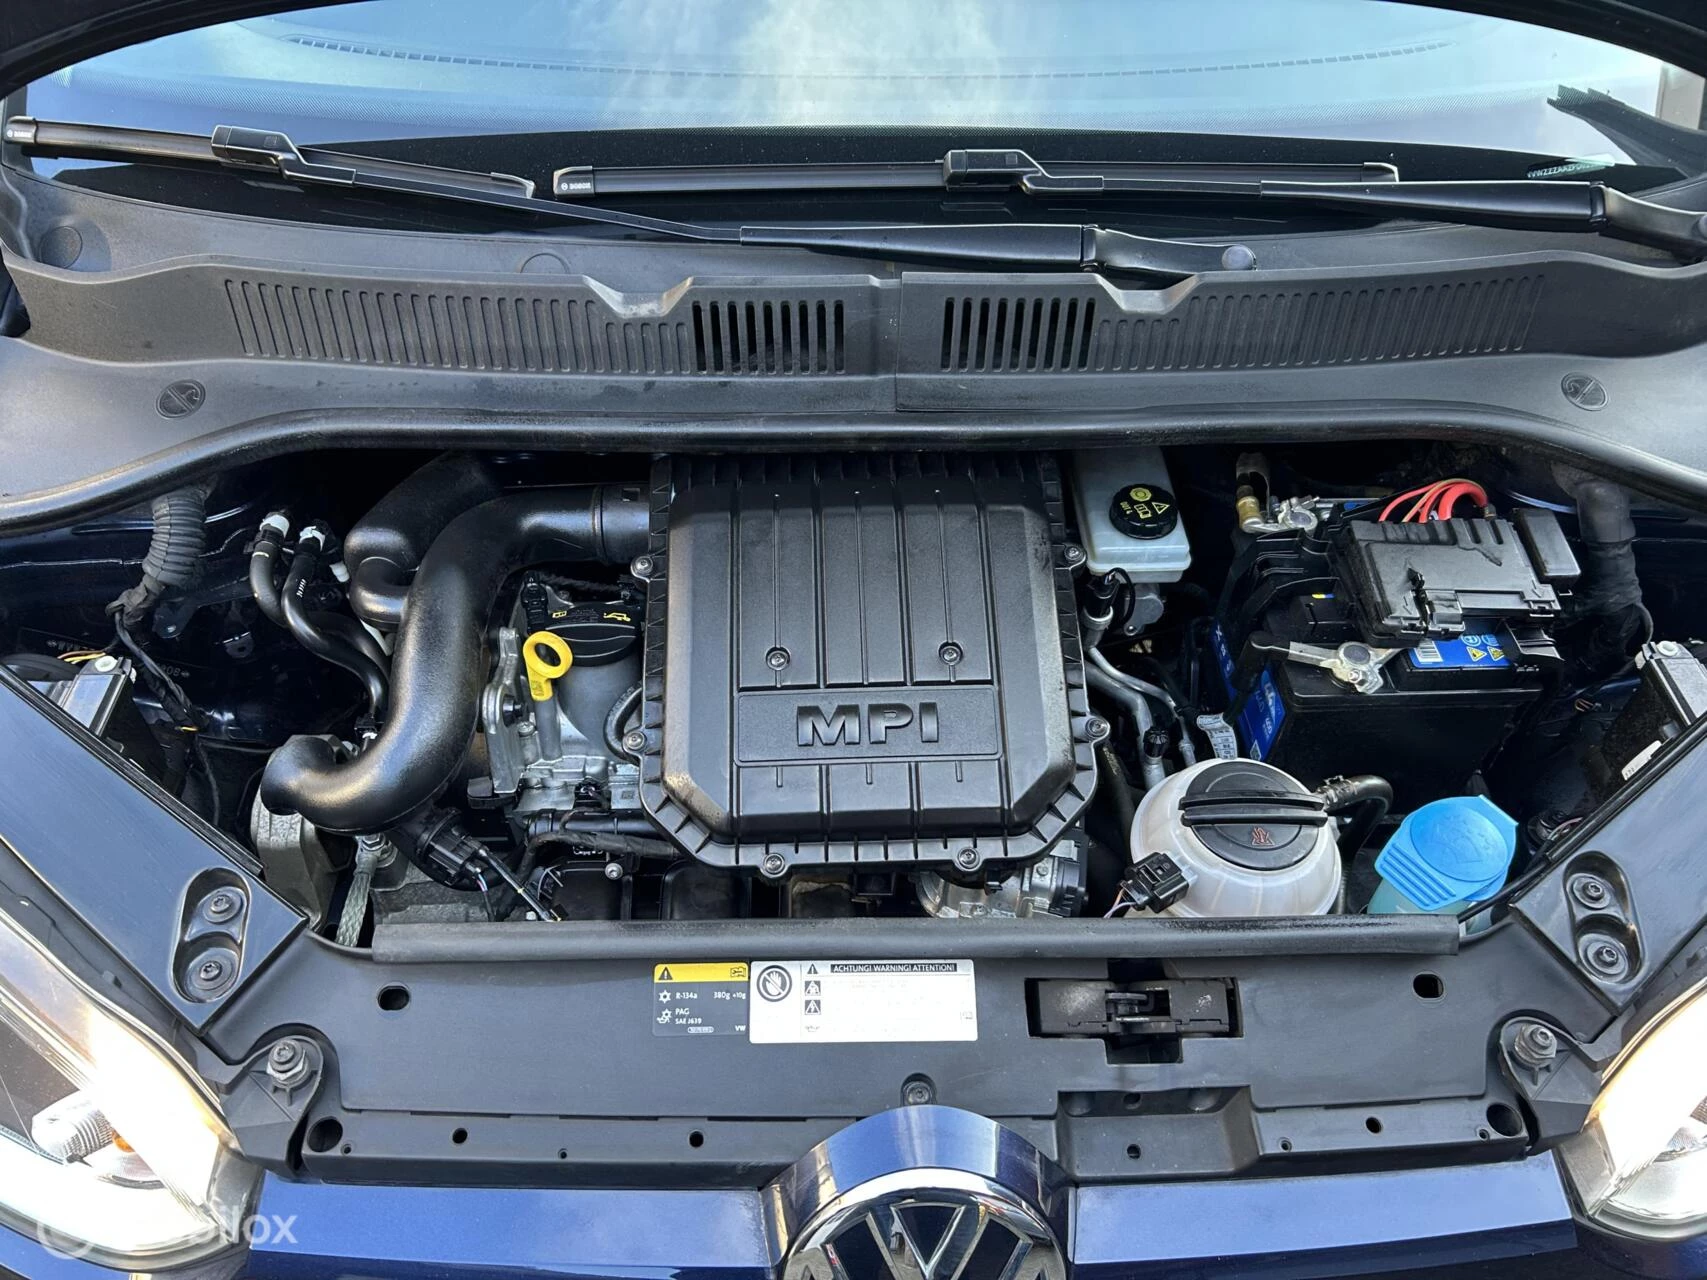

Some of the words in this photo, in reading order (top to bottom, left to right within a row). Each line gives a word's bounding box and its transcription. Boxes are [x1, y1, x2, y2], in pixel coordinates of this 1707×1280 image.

[569, 182, 591, 190] BOSCH
[796, 701, 940, 747] MPI
[675, 991, 698, 1000] R-134a
[713, 991, 731, 1001] 380g
[675, 1007, 690, 1016] PAG
[675, 1017, 687, 1025] SAE
[734, 1024, 747, 1032] VW
